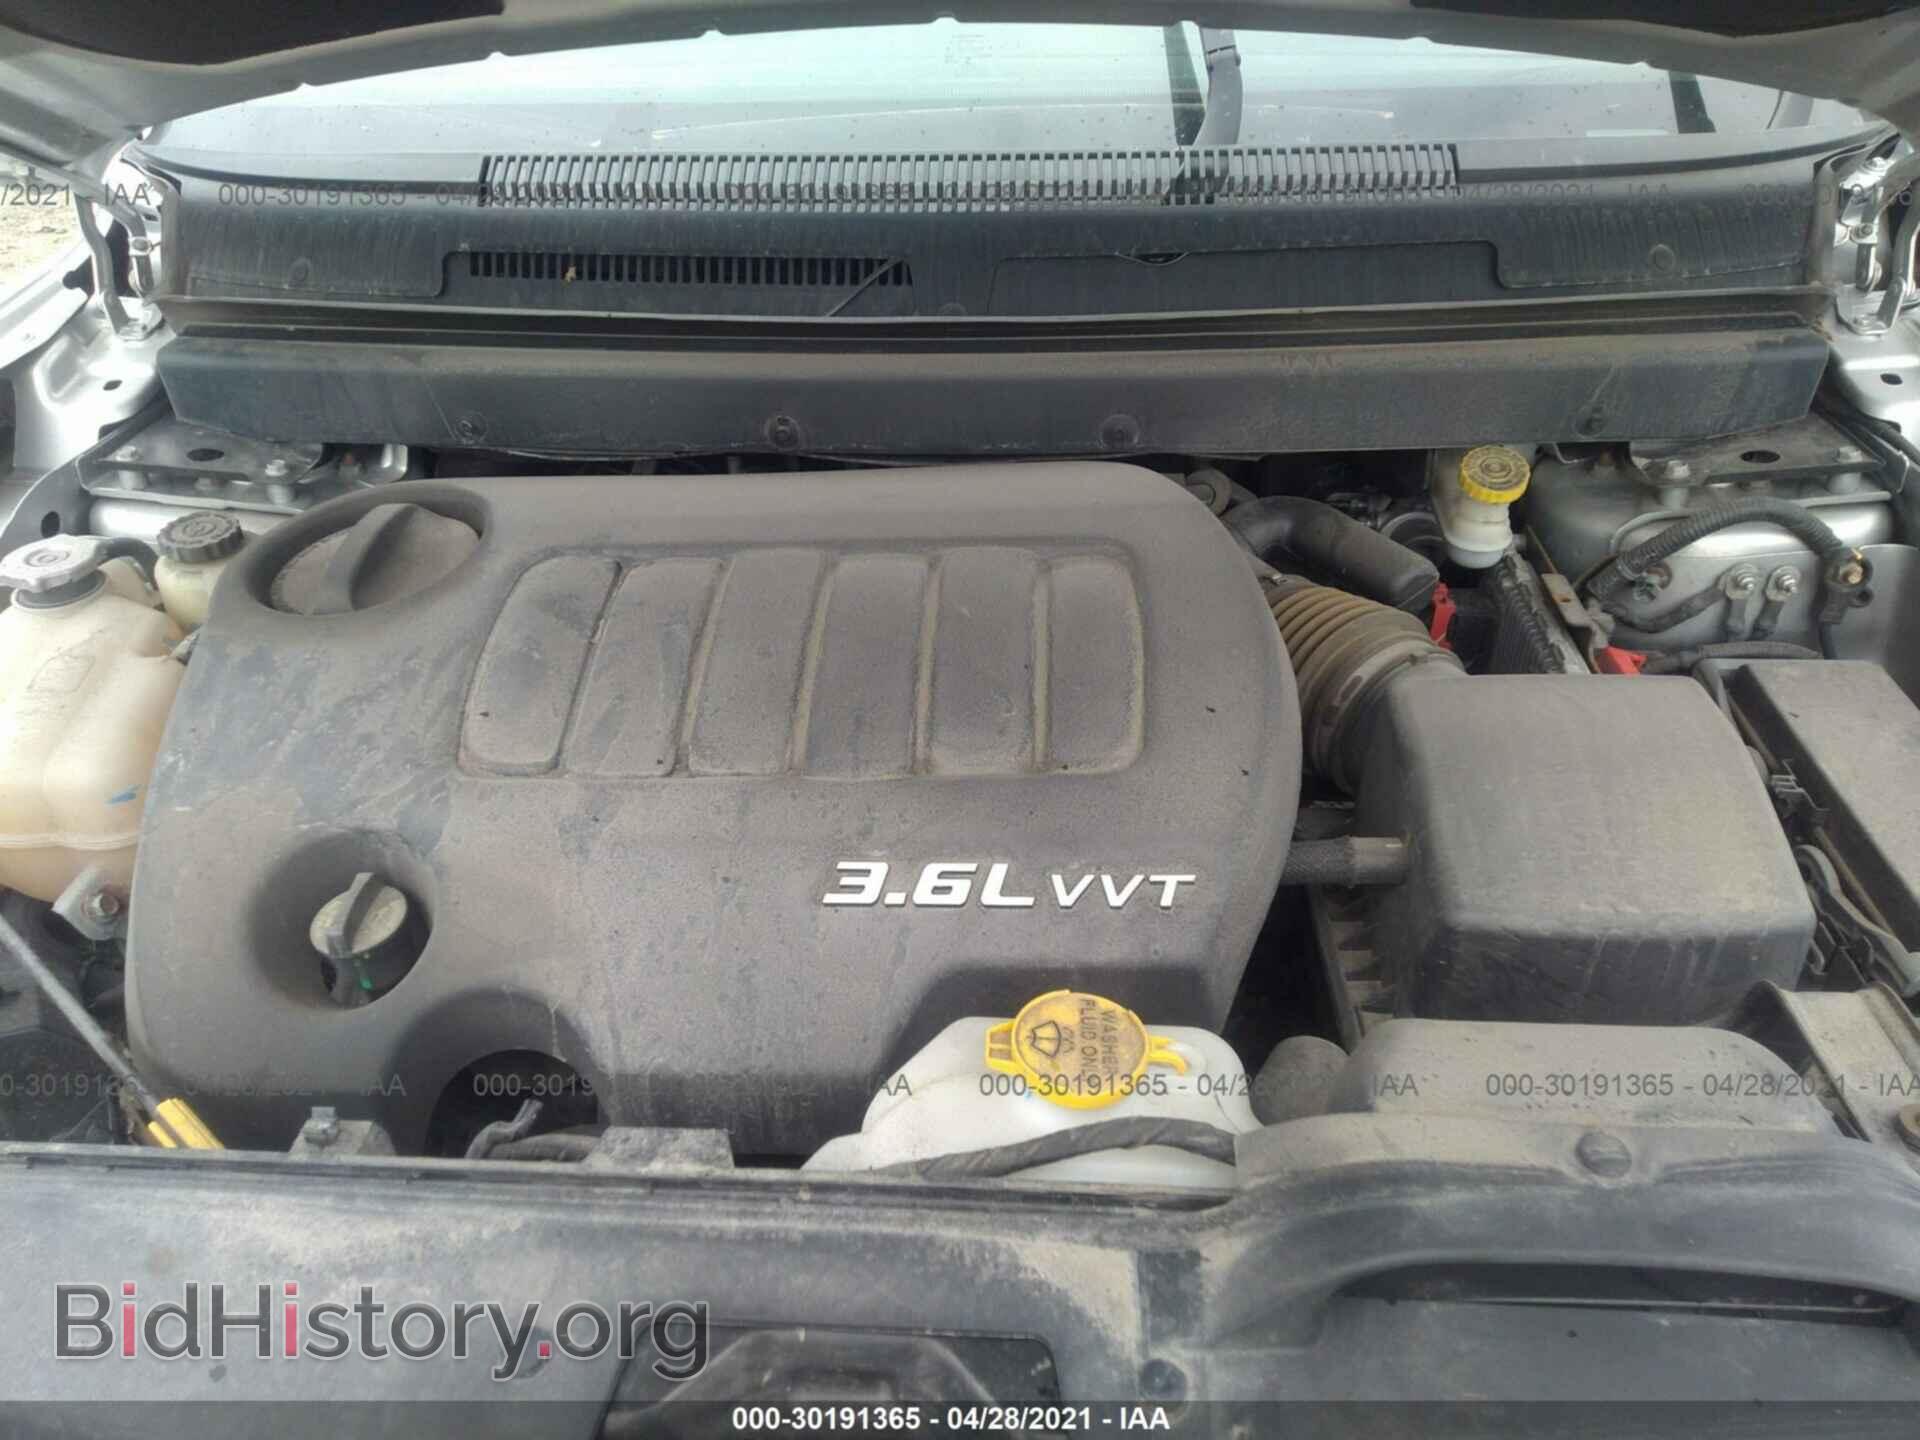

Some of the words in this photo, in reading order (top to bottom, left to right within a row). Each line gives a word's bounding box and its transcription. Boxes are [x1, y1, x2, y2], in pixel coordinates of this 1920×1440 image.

[822, 861, 1036, 907] 3.6L
[1050, 873, 1197, 909] VVT
[1079, 998, 1097, 1040] FLUID
[1100, 1009, 1120, 1075] WASHER
